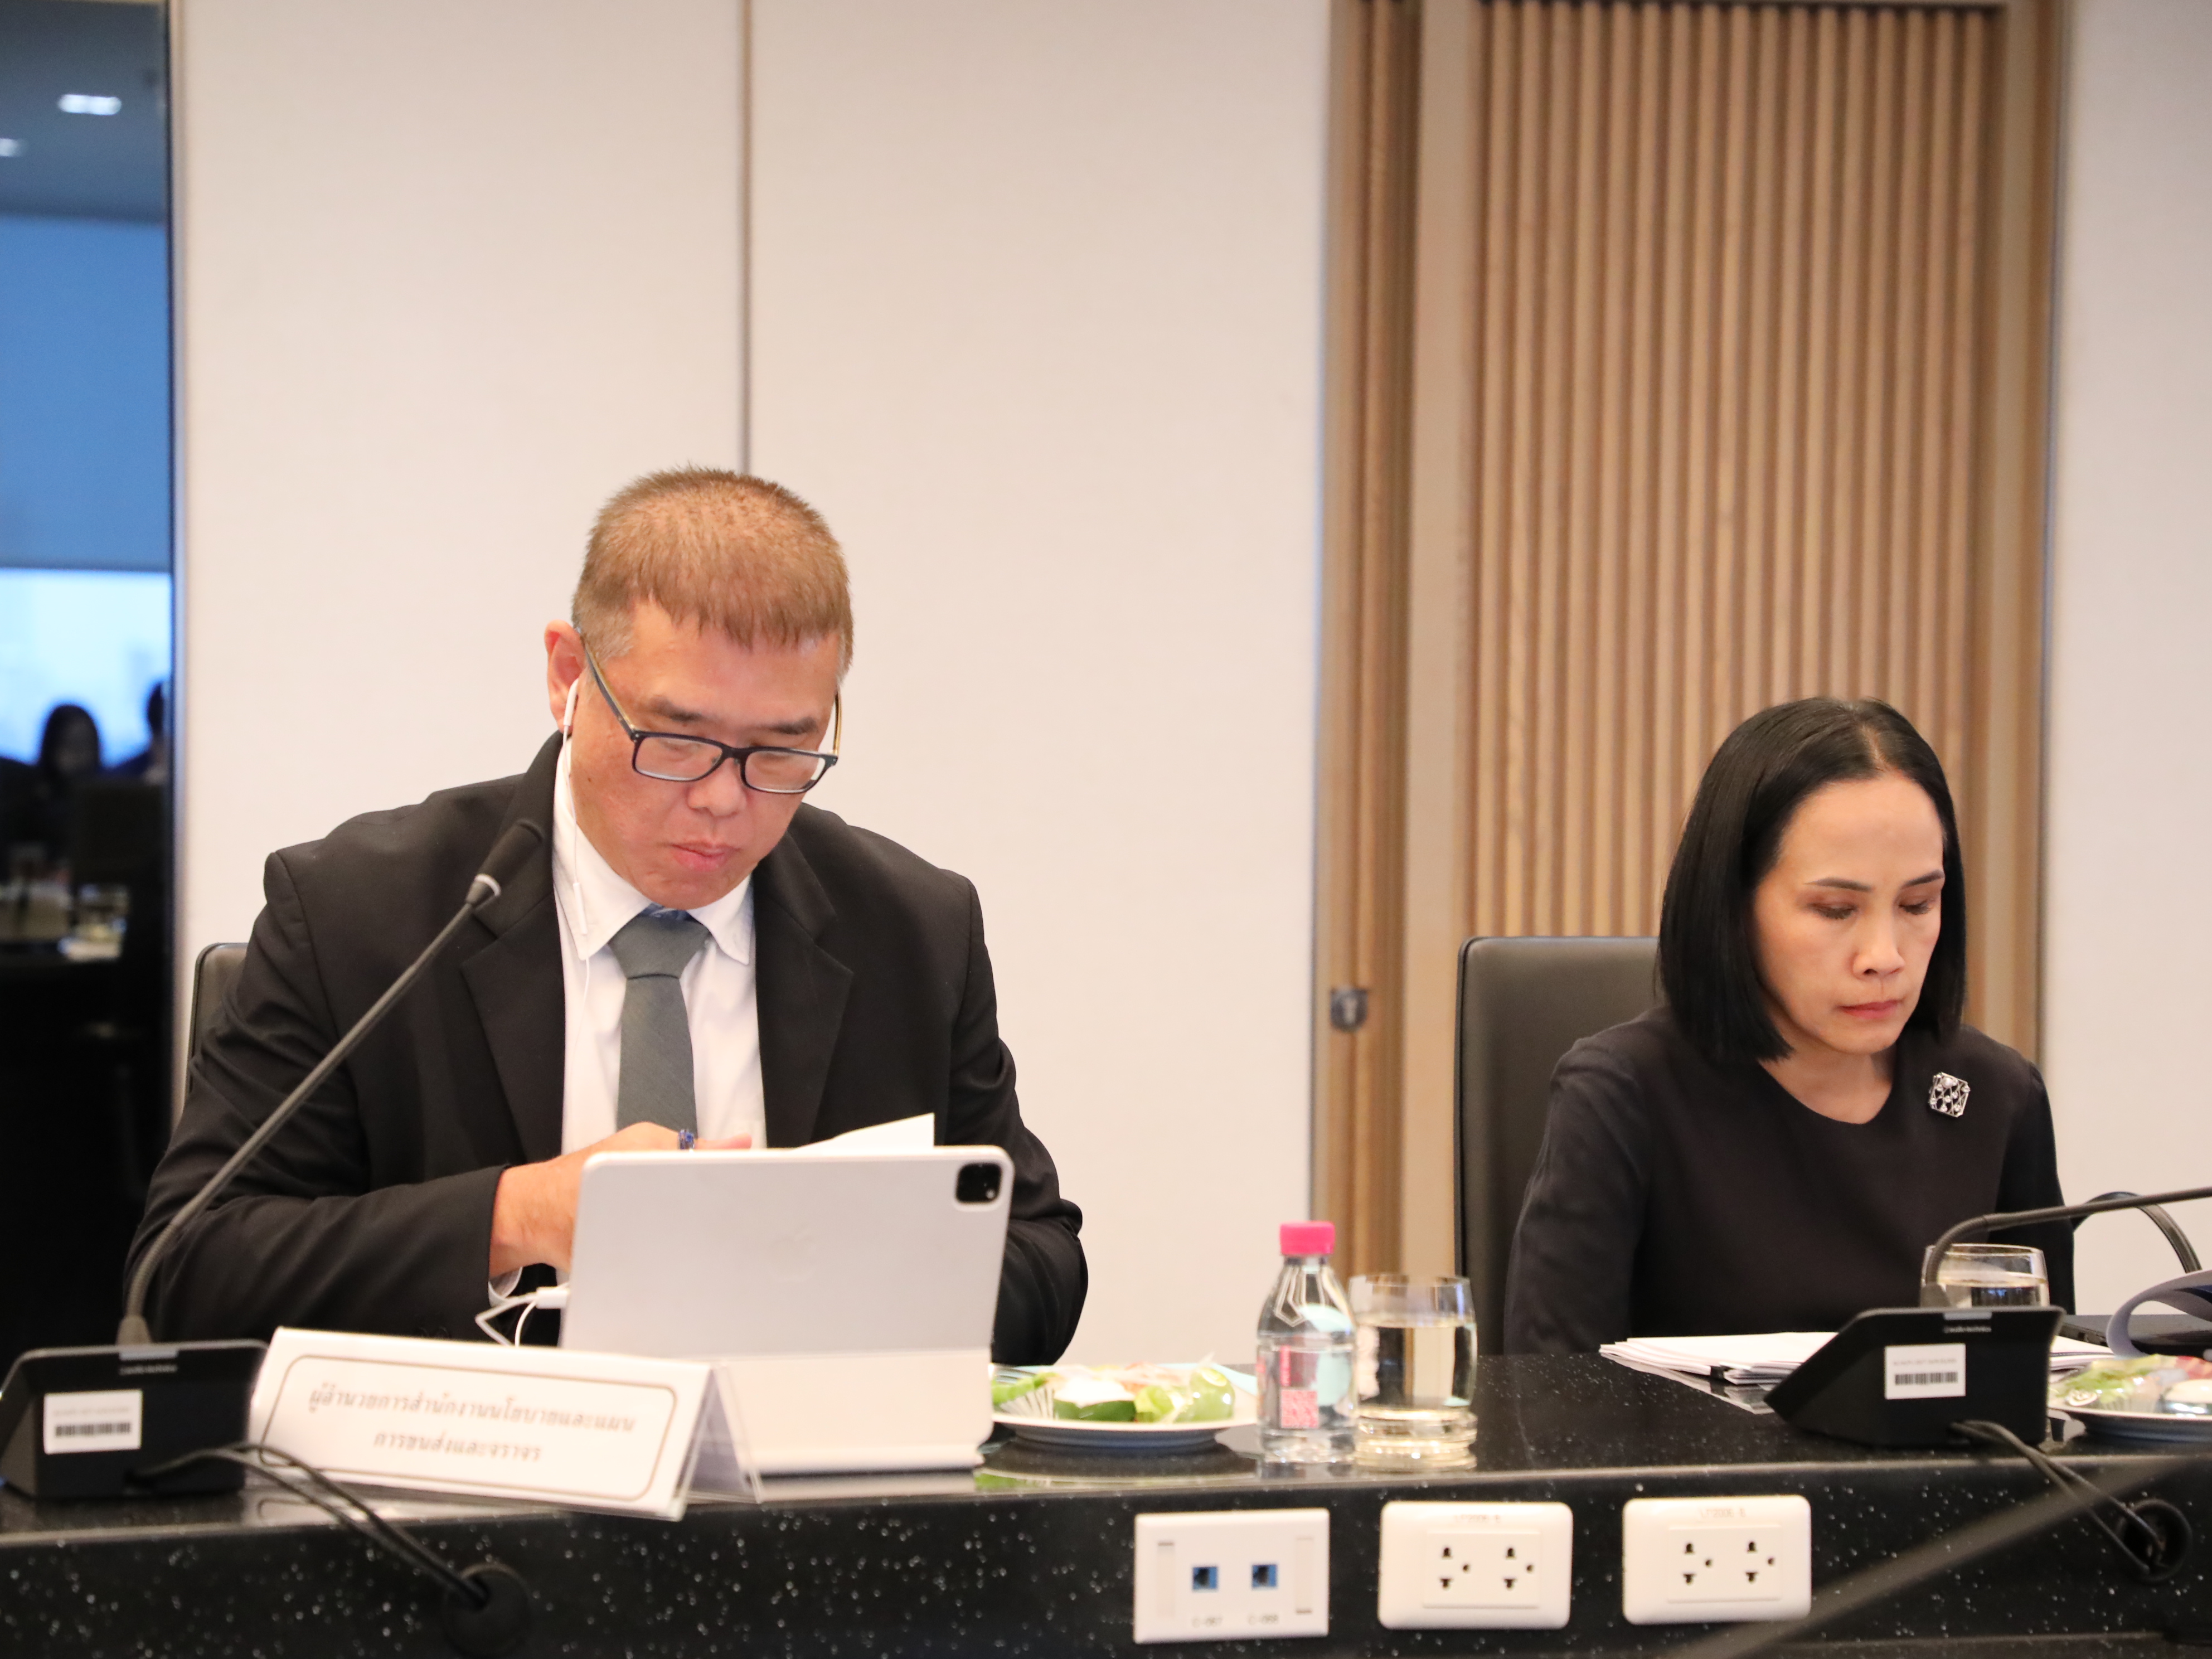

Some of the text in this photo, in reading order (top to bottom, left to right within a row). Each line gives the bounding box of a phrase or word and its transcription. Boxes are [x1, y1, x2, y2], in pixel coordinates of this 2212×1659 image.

[309, 1381, 636, 1432] ผู้อำนวยการสำนักงานนโยบายและแผน
[373, 1430, 541, 1462] การขนส่งและจราจร
